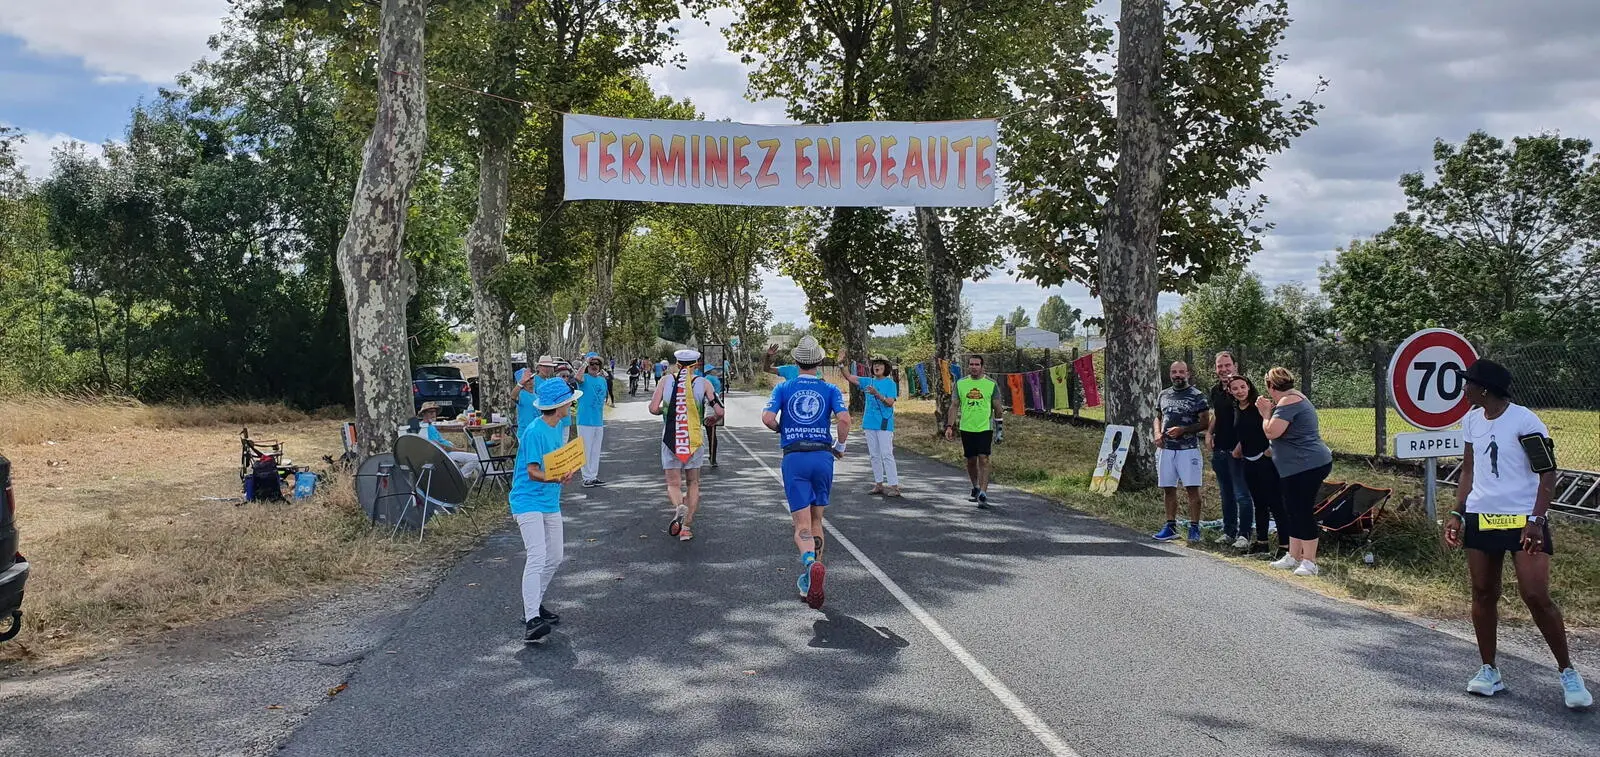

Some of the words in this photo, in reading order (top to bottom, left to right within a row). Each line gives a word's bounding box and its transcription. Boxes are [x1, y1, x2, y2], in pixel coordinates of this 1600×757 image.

[571, 131, 781, 189] TERMINEZ
[795, 136, 842, 189] EN
[855, 135, 994, 191] BEAUTE
[1413, 361, 1463, 401] 70
[675, 368, 690, 455] DEUTSCHLAND
[1410, 438, 1459, 451] RAPPEL
